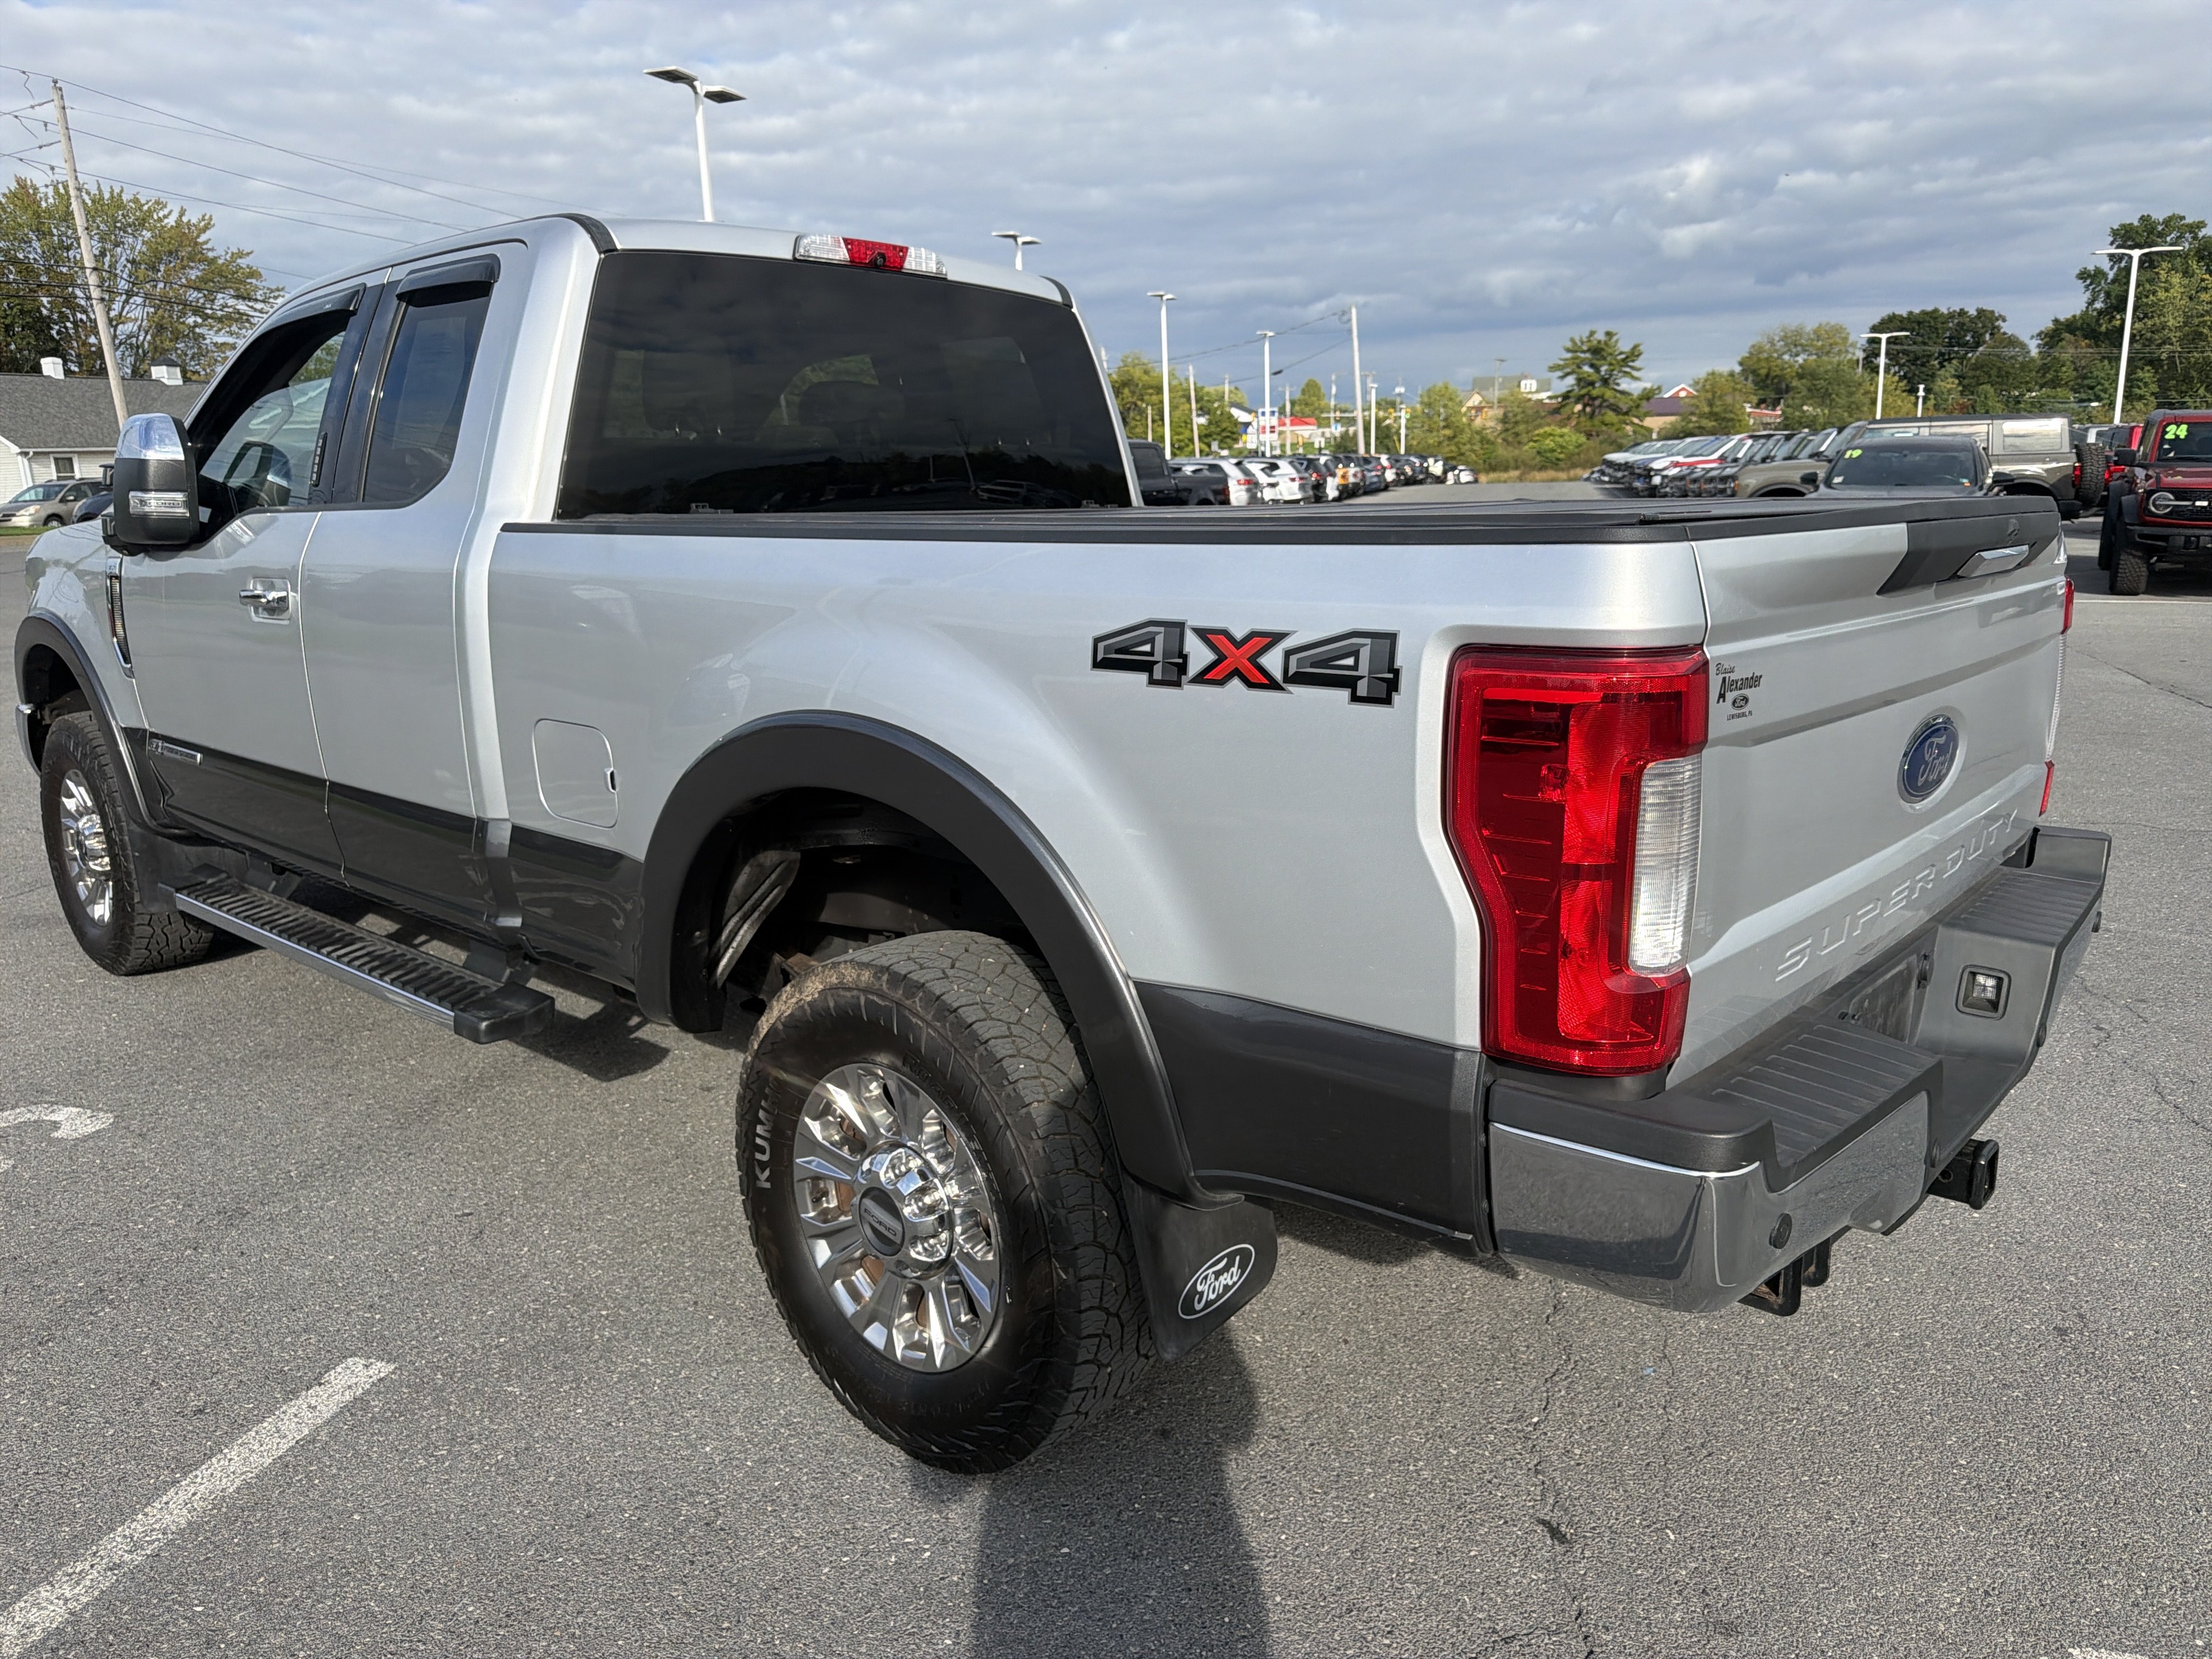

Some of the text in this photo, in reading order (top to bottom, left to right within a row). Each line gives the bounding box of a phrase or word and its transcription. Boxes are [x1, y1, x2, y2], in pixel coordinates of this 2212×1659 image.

[2164, 424, 2189, 439] 24
[1843, 448, 1863, 459] 19
[1715, 662, 1736, 676] Blaise
[1716, 672, 1763, 704] Alexander
[1917, 733, 1953, 787] Ford
[1775, 808, 2018, 982] SUPER DUTY
[864, 1207, 897, 1237] FORD
[1194, 1255, 1242, 1311] Ford
